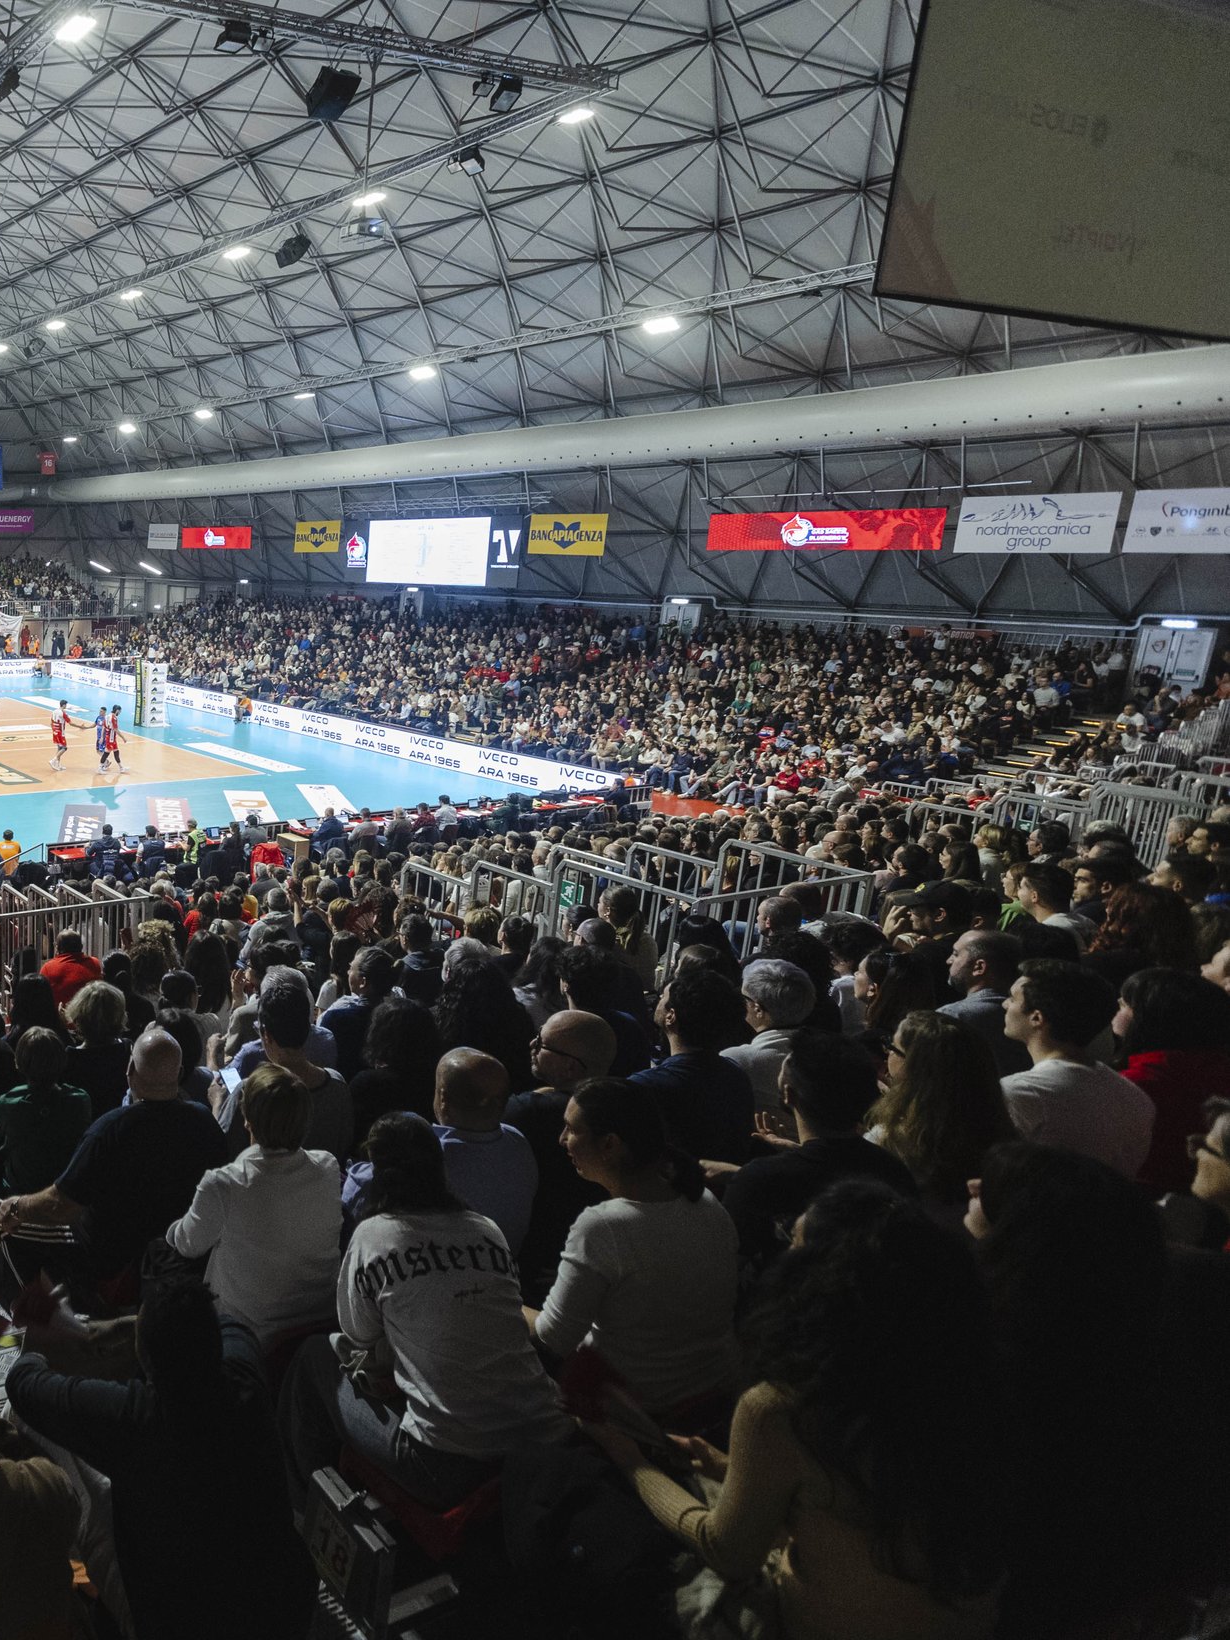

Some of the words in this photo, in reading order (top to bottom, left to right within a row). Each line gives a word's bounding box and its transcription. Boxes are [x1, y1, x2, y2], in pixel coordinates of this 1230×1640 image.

[44, 459, 53, 467] 16
[531, 529, 603, 542] BANCAPIACENZA
[975, 522, 1091, 536] nordmeccanica
[1006, 536, 1051, 551] group
[254, 703, 279, 714] IVECO
[301, 713, 329, 725] IVECO
[301, 725, 319, 735] ARA
[321, 729, 342, 741] 1965
[355, 724, 386, 737] IVECO
[355, 737, 375, 748] ARA
[377, 742, 401, 754] 1965
[409, 736, 444, 750] IVECO
[408, 750, 432, 762] ARA
[434, 755, 461, 769] 1965
[478, 750, 519, 766] IVECO
[477, 765, 504, 778] ARA
[508, 772, 539, 786] 1965
[560, 767, 607, 785] IVECO
[558, 783, 588, 793] AR
[316, 1521, 350, 1582] 18
